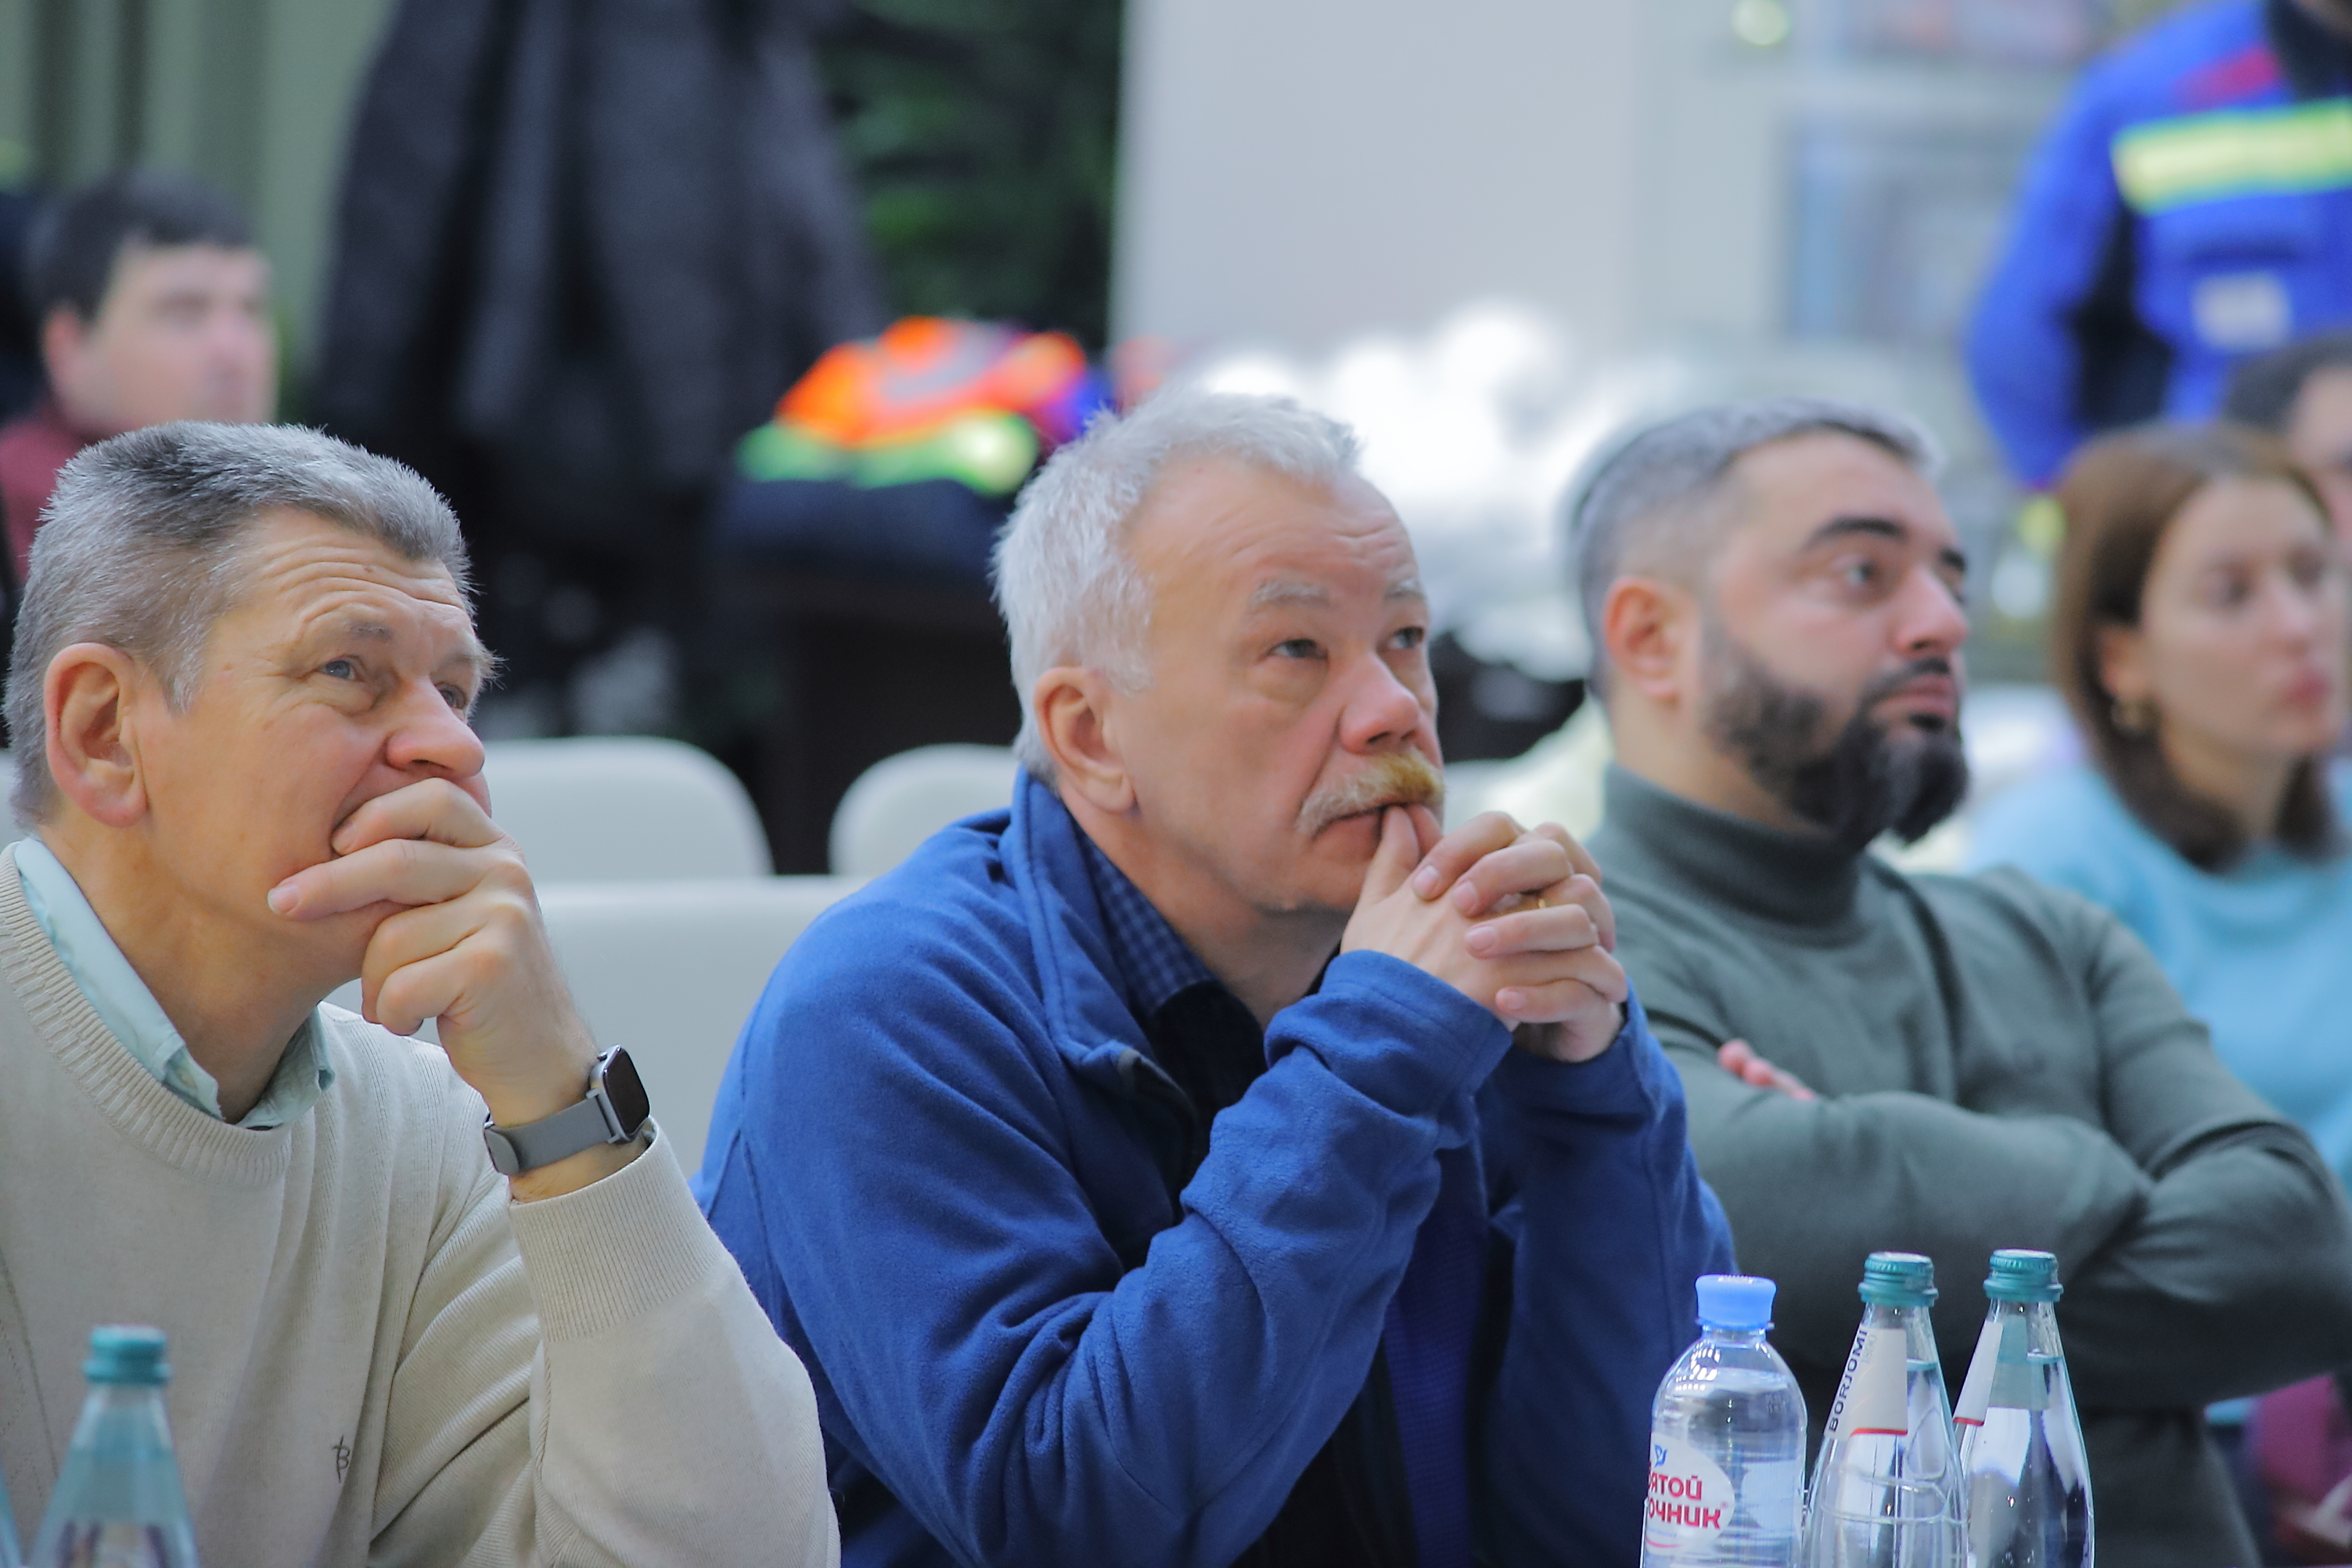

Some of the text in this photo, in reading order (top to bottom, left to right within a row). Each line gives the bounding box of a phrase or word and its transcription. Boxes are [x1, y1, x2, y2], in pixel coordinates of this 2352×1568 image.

[1829, 1329, 1868, 1433] BORJOMI
[1649, 1461, 1703, 1501] ятой
[1648, 1496, 1721, 1530] очник
